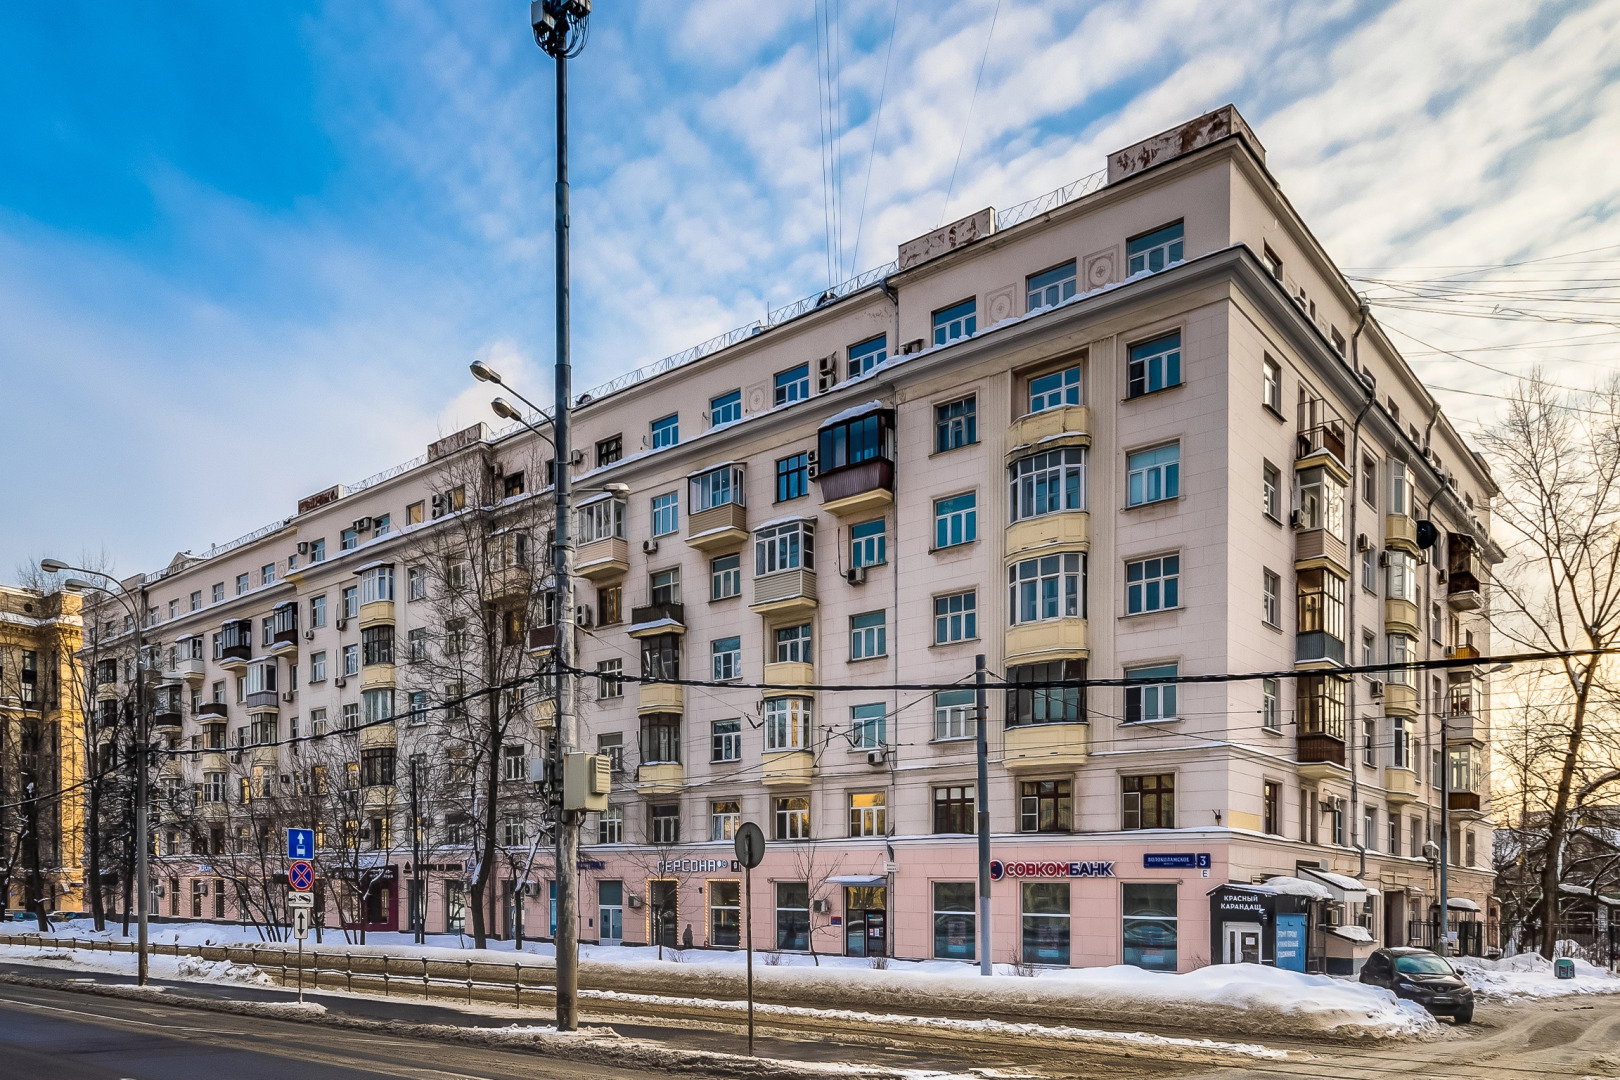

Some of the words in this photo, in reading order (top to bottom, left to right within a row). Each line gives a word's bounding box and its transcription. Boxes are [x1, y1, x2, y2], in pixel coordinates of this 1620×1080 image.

[1199, 855, 1207, 866] 3
[1004, 862, 1115, 877] СОВКОМБАНК
[1223, 894, 1259, 902] КРАСНЫЙ
[1220, 903, 1262, 911] КАРАНДАШ
